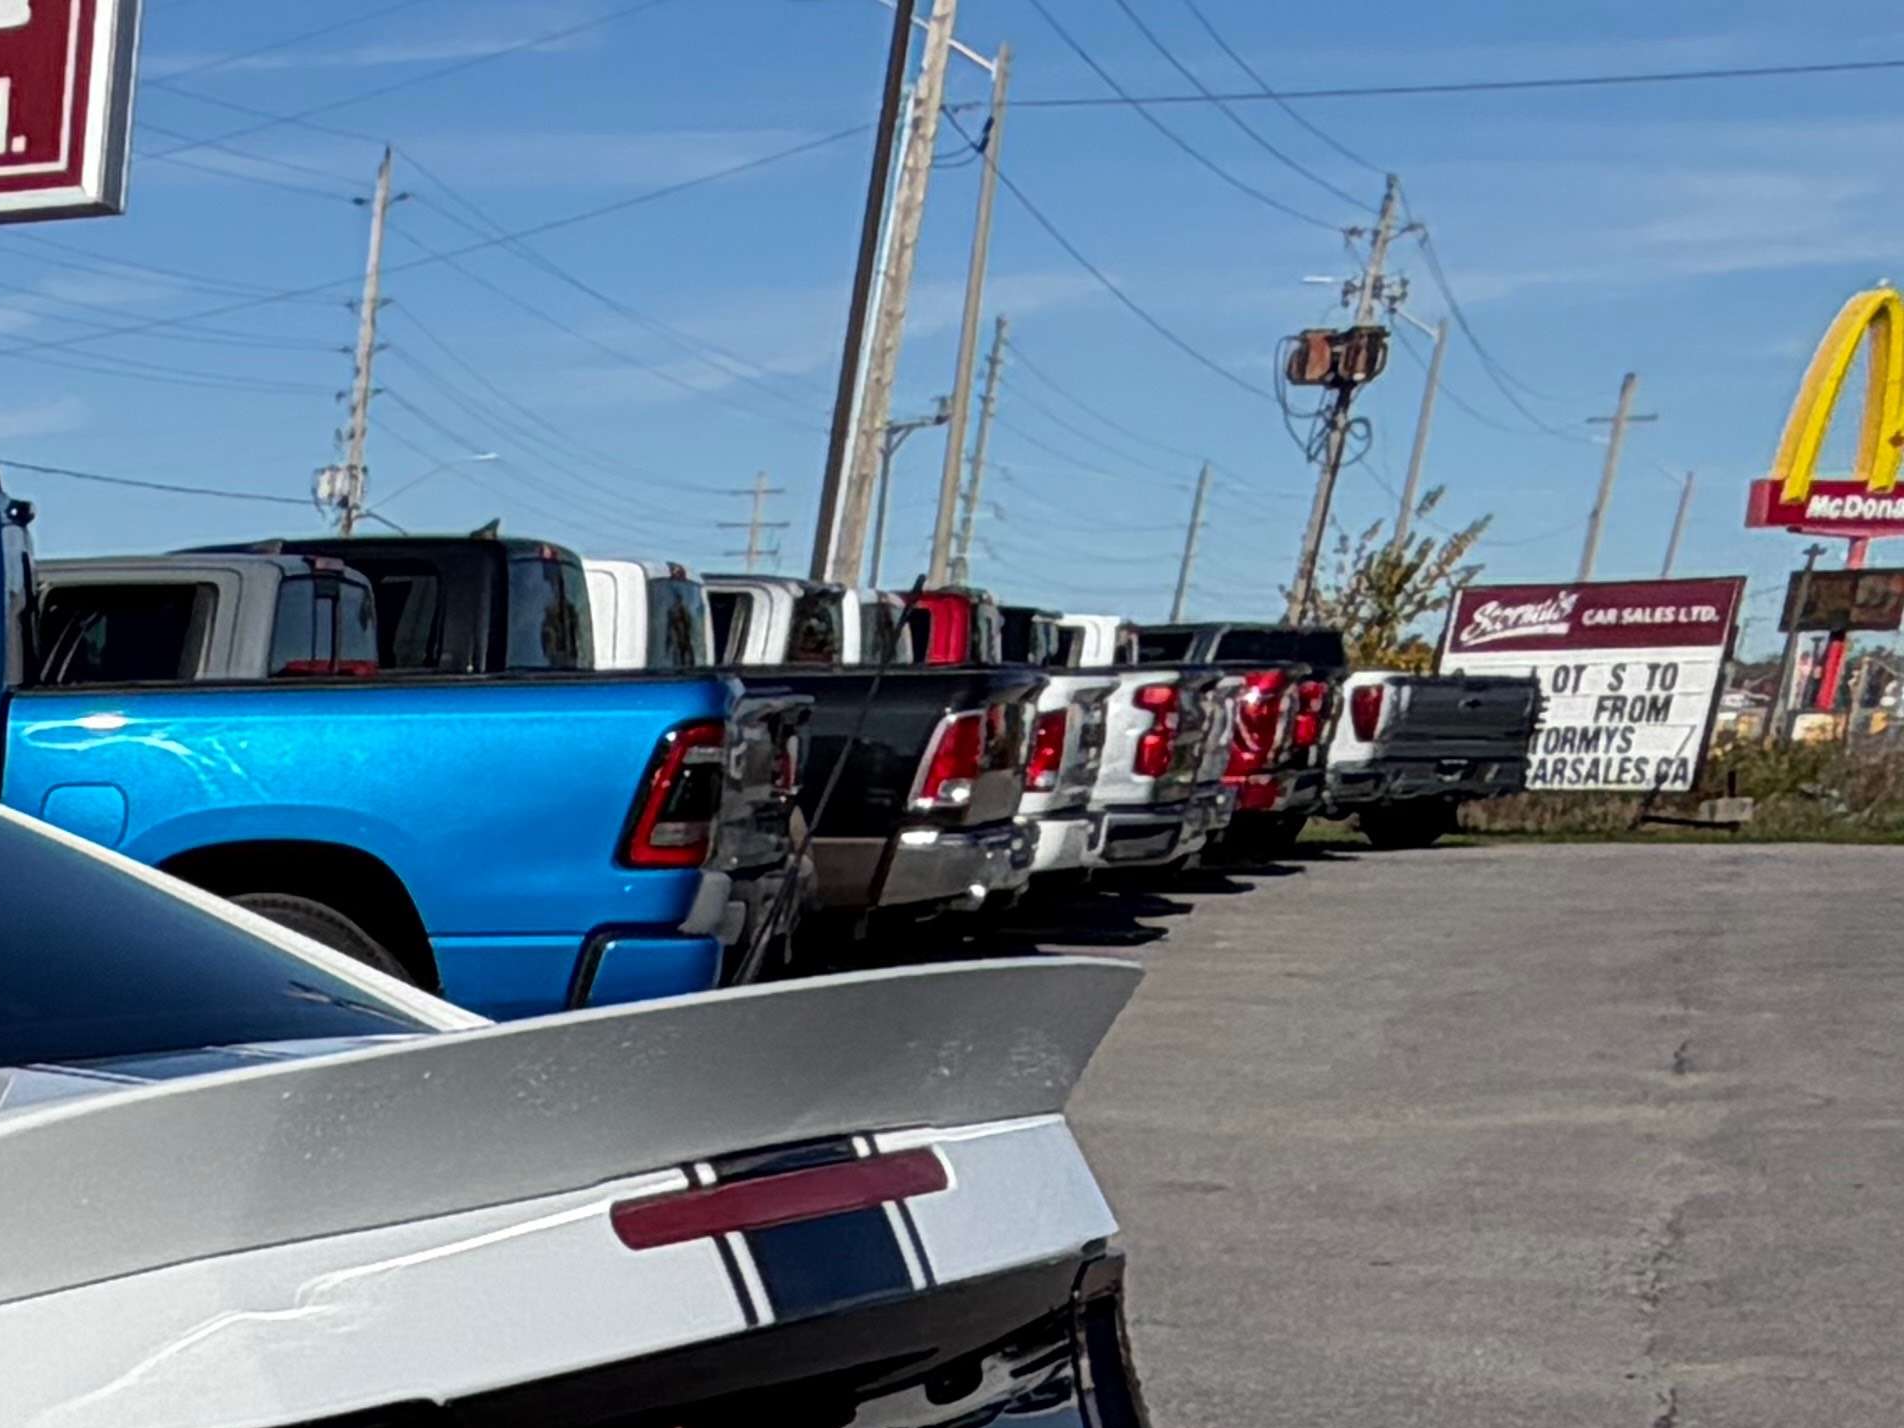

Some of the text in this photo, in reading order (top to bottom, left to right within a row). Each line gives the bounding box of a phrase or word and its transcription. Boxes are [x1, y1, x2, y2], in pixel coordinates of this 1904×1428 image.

[1582, 606, 1618, 626] CAR
[1621, 604, 1677, 625] SALES
[1646, 662, 1680, 692] TO
[1593, 694, 1674, 723] FROM
